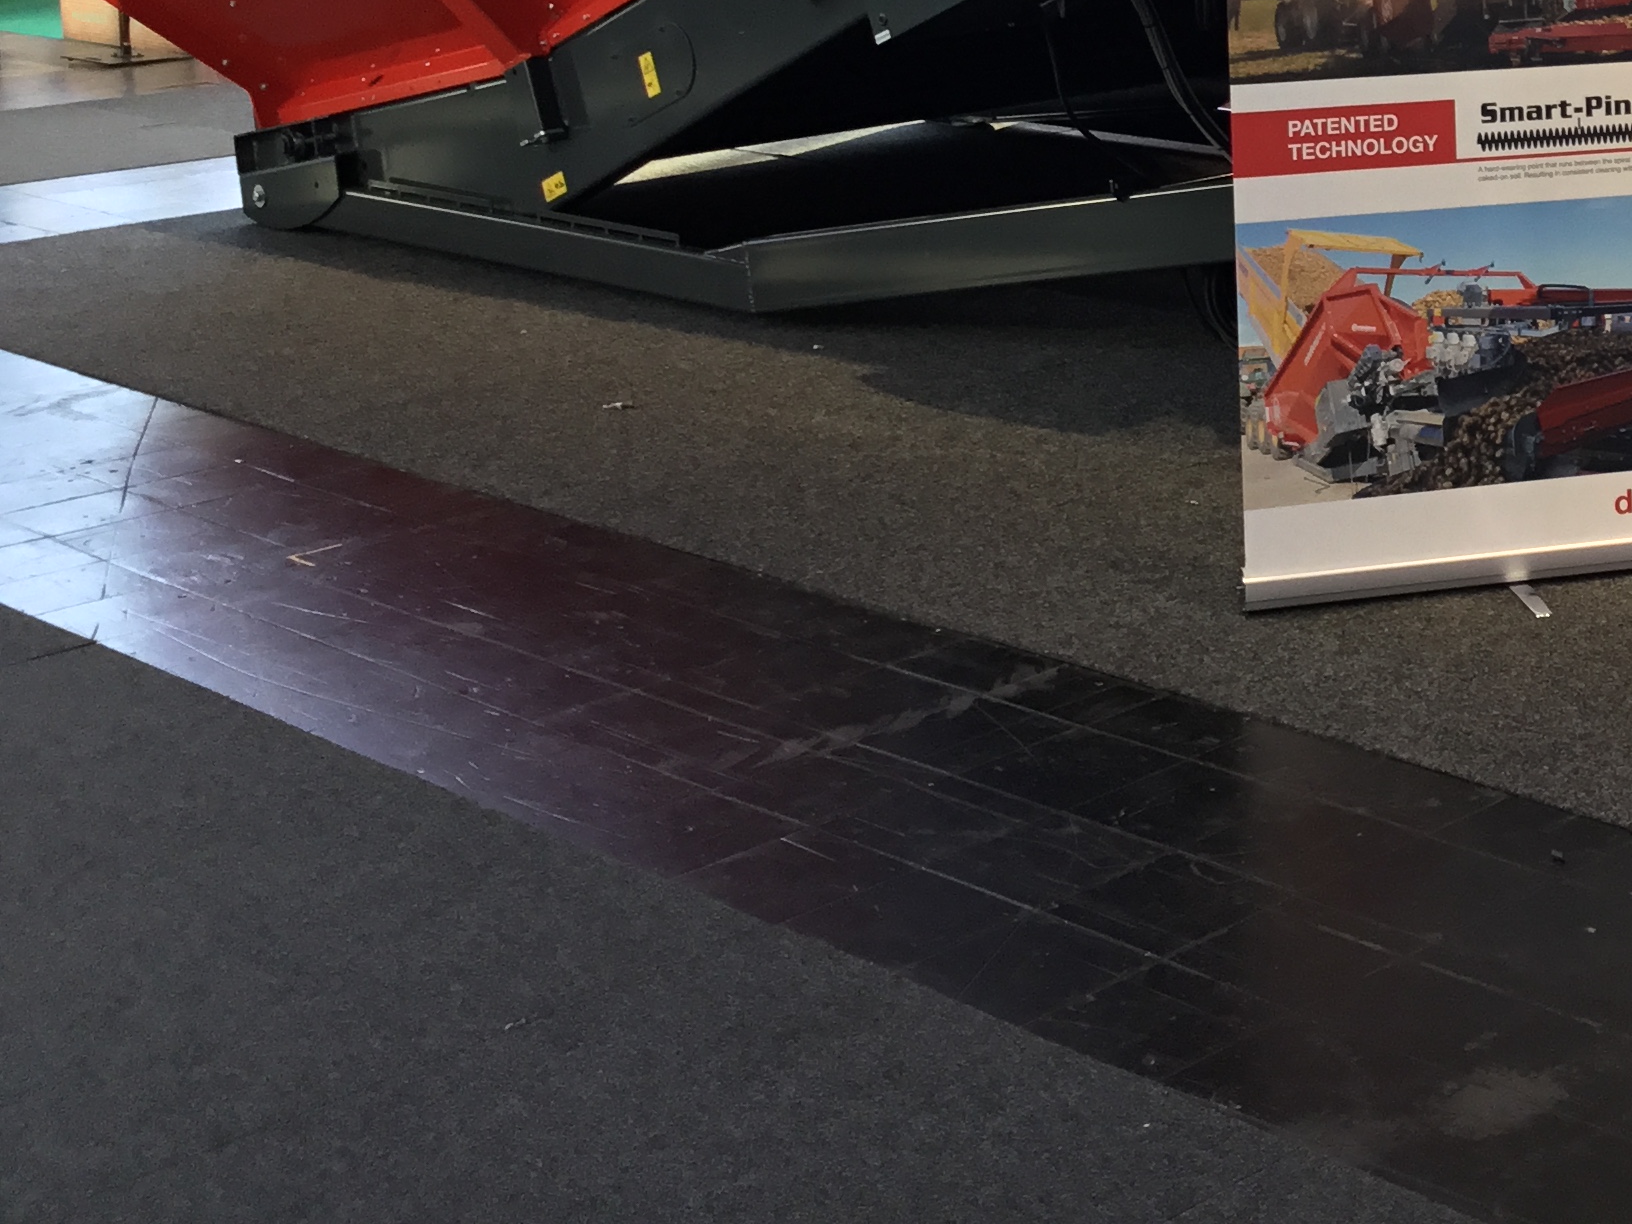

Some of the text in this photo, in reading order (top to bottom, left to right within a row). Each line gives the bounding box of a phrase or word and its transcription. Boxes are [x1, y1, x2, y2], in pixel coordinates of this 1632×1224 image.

[1481, 95, 1632, 124] Smart-Pin
[1287, 114, 1399, 138] PATENTED
[1288, 134, 1439, 162] TECHNOLOGY
